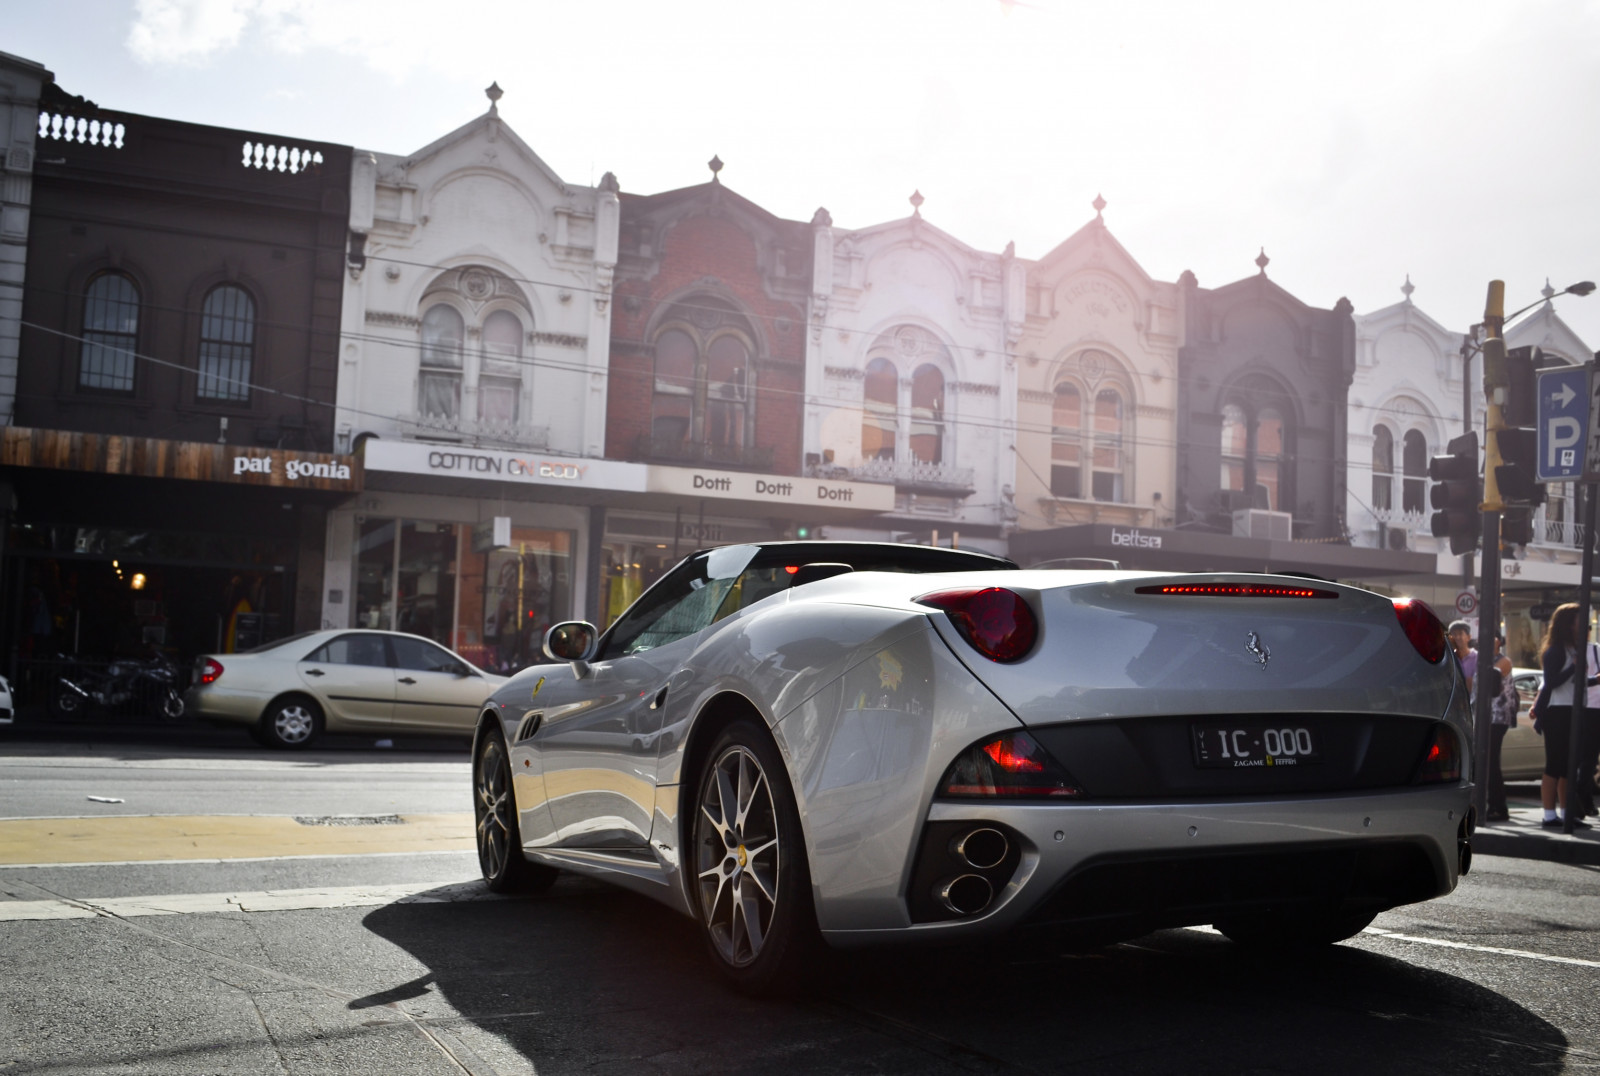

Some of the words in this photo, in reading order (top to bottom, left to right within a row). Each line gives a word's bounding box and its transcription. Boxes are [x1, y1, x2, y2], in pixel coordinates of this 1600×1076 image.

[1547, 416, 1581, 468] P
[233, 456, 272, 475] pat
[286, 459, 351, 480] gonia
[429, 451, 502, 474] COTTON
[507, 458, 533, 477] ON
[540, 462, 587, 481] BODY
[693, 474, 732, 491] Dotti
[755, 480, 794, 497] Dotti
[817, 485, 854, 502] Dotti
[1112, 528, 1149, 548] betts
[1460, 597, 1473, 609] 40
[1233, 759, 1265, 767] ZAGAME
